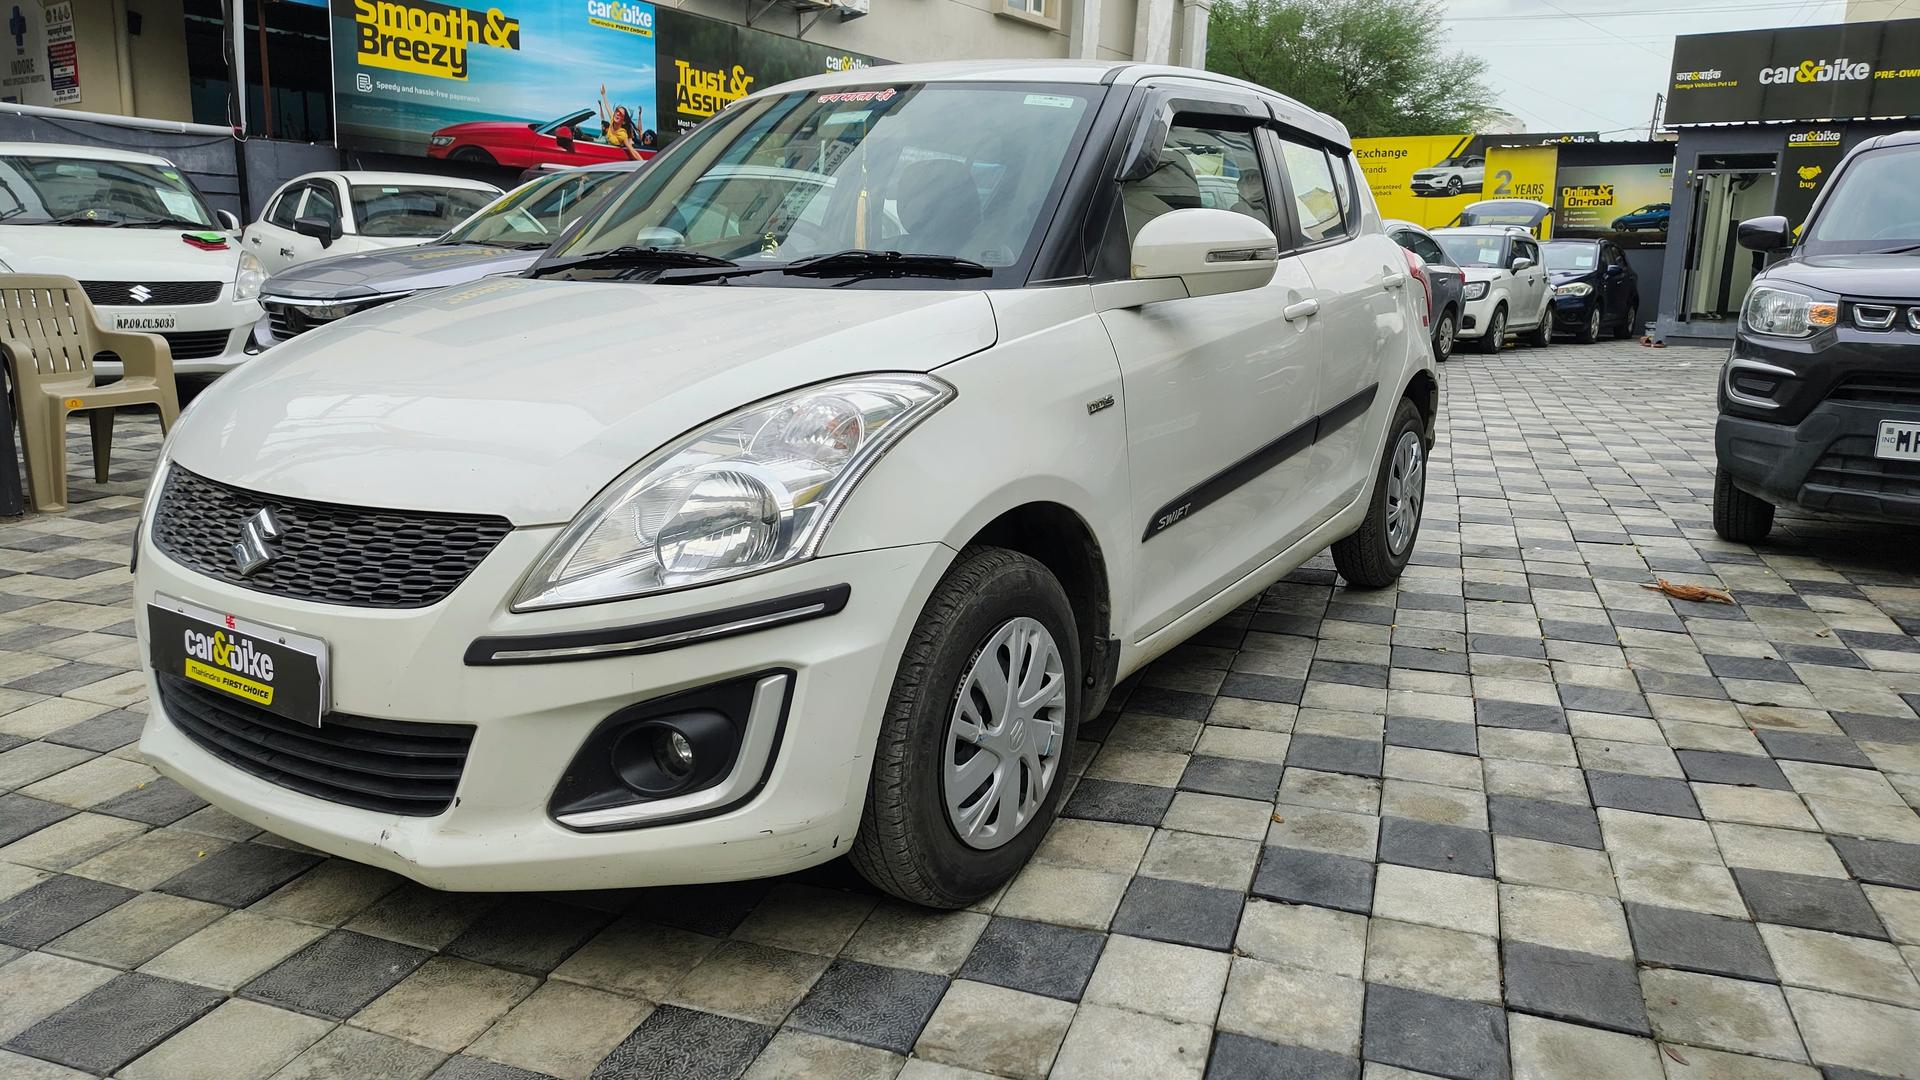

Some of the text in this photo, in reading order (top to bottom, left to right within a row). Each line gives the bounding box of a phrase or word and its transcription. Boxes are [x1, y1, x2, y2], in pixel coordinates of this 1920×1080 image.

[587, 0, 653, 28] car&bike
[354, 0, 520, 50] Smooth &
[358, 22, 467, 78] Breezy
[10, 58, 35, 76] INDORE
[1758, 58, 1871, 85] car&bike
[675, 60, 754, 97] Trust &
[376, 81, 401, 92] Speedy
[401, 86, 414, 94] and
[414, 87, 449, 98] hassle-free
[677, 119, 691, 128] Most
[1789, 130, 1841, 142] car&bike
[1356, 149, 1408, 159] Exchange
[1493, 170, 1545, 195] 2 YEARS
[1562, 182, 1615, 197] Online &
[1799, 181, 1817, 190] buy
[1568, 196, 1614, 207] On-road
[1881, 436, 1896, 444] IND
[1157, 502, 1192, 531] SWIFT
[184, 628, 275, 682] car&bike
[222, 677, 243, 690] FIRST
[243, 685, 270, 700] CHOICE
